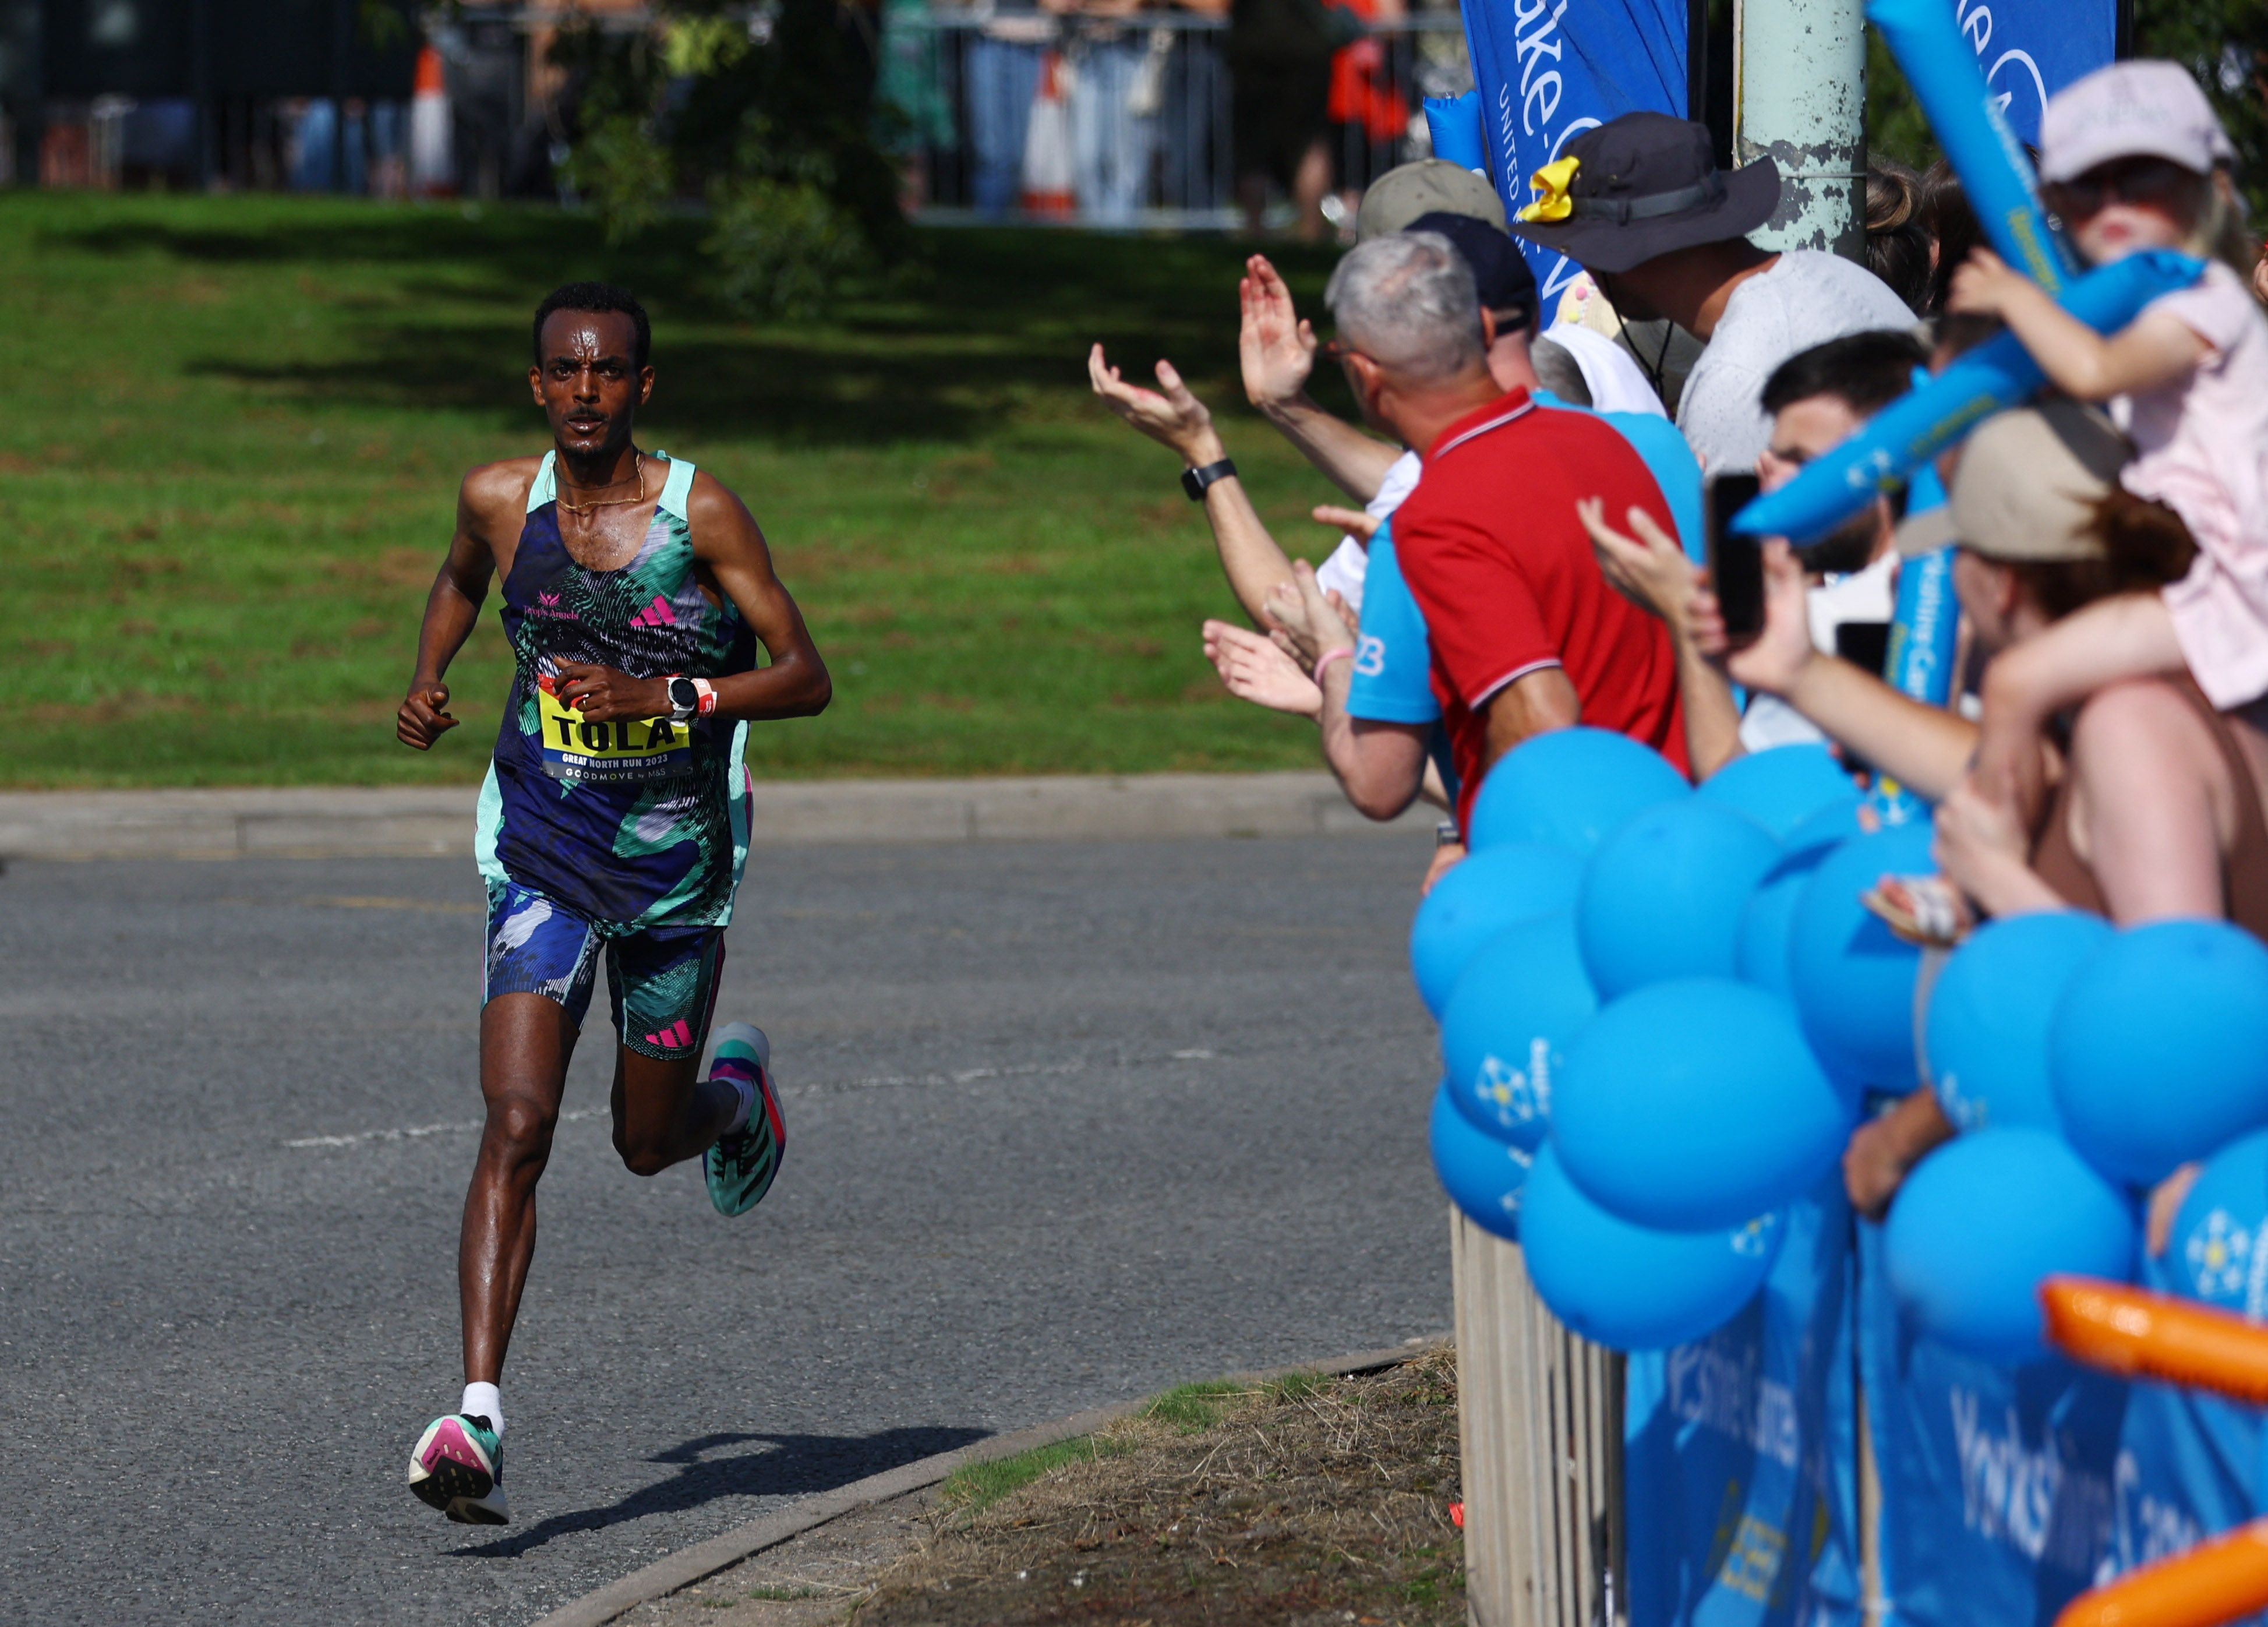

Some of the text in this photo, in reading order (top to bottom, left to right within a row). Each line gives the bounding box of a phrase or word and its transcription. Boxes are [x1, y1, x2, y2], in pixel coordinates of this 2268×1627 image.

[1498, 82, 1520, 201] UNITED
[549, 609, 579, 620] Angels
[552, 715, 676, 751] TOLA
[562, 753, 668, 768] GREAT NORTH RUN 2023
[566, 768, 633, 781] GOODMOVE
[648, 768, 666, 779] M&S
